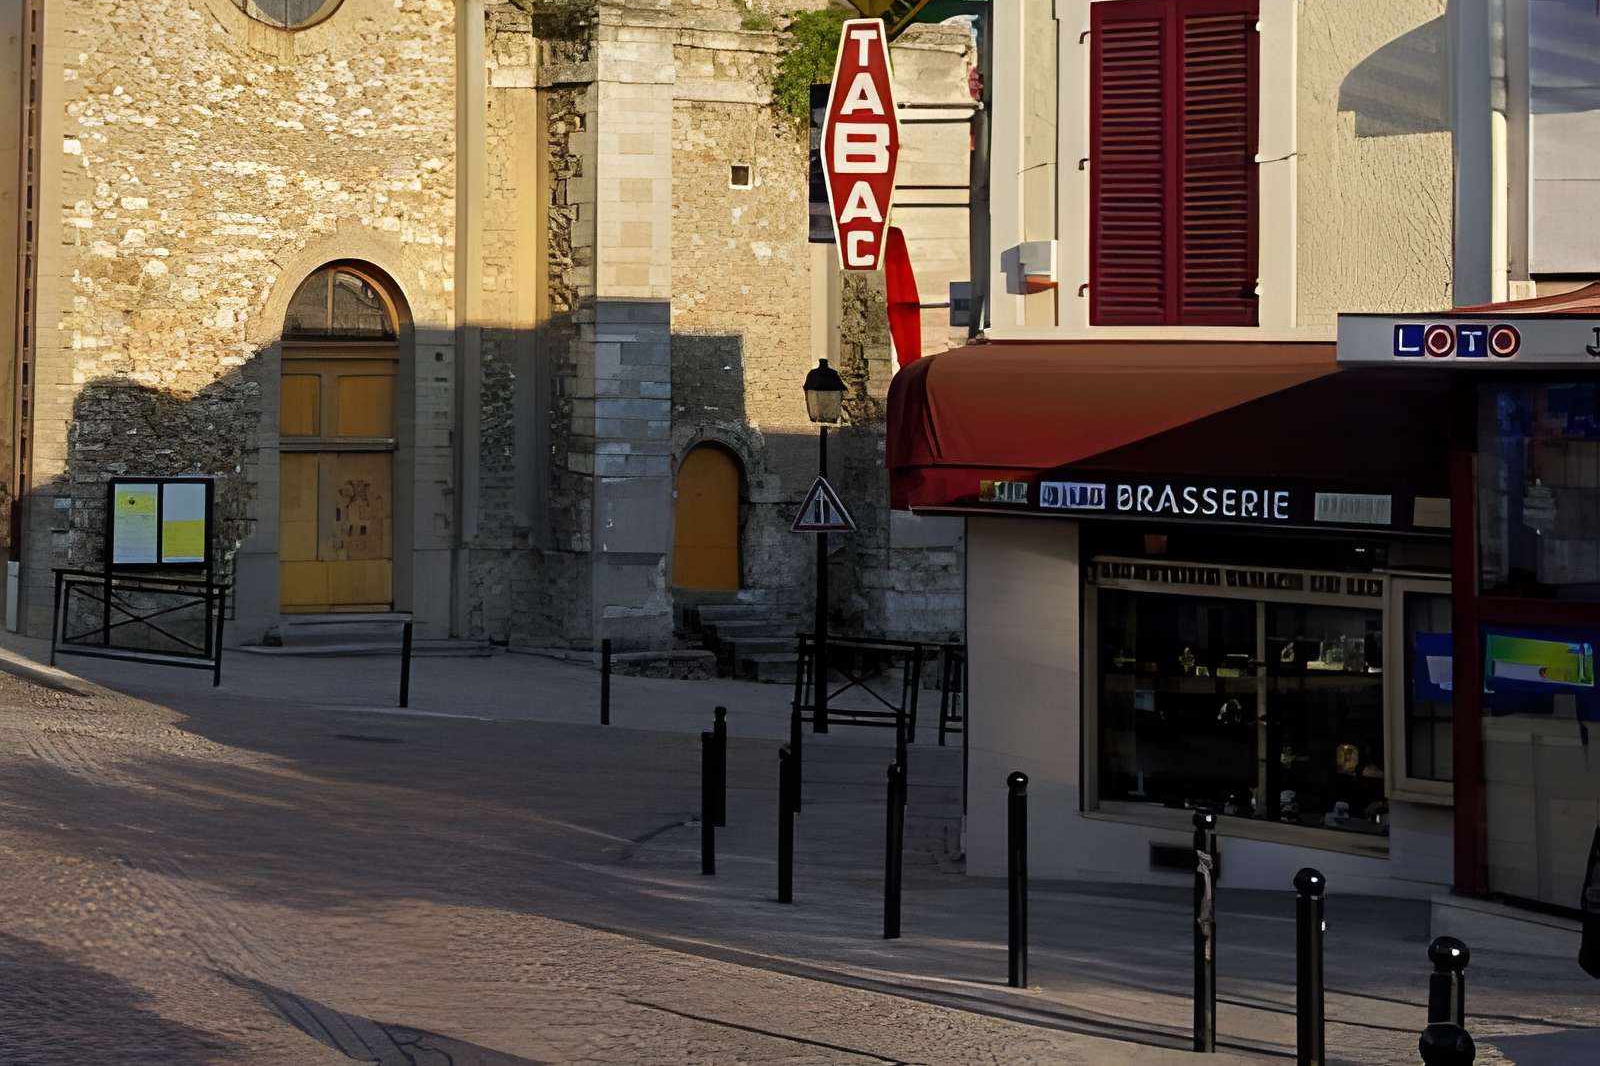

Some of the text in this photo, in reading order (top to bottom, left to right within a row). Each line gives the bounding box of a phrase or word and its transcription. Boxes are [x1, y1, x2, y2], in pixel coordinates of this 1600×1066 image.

[834, 29, 890, 266] TABAC
[1396, 325, 1518, 355] LOTO
[1116, 484, 1290, 520] BRASSERIE
